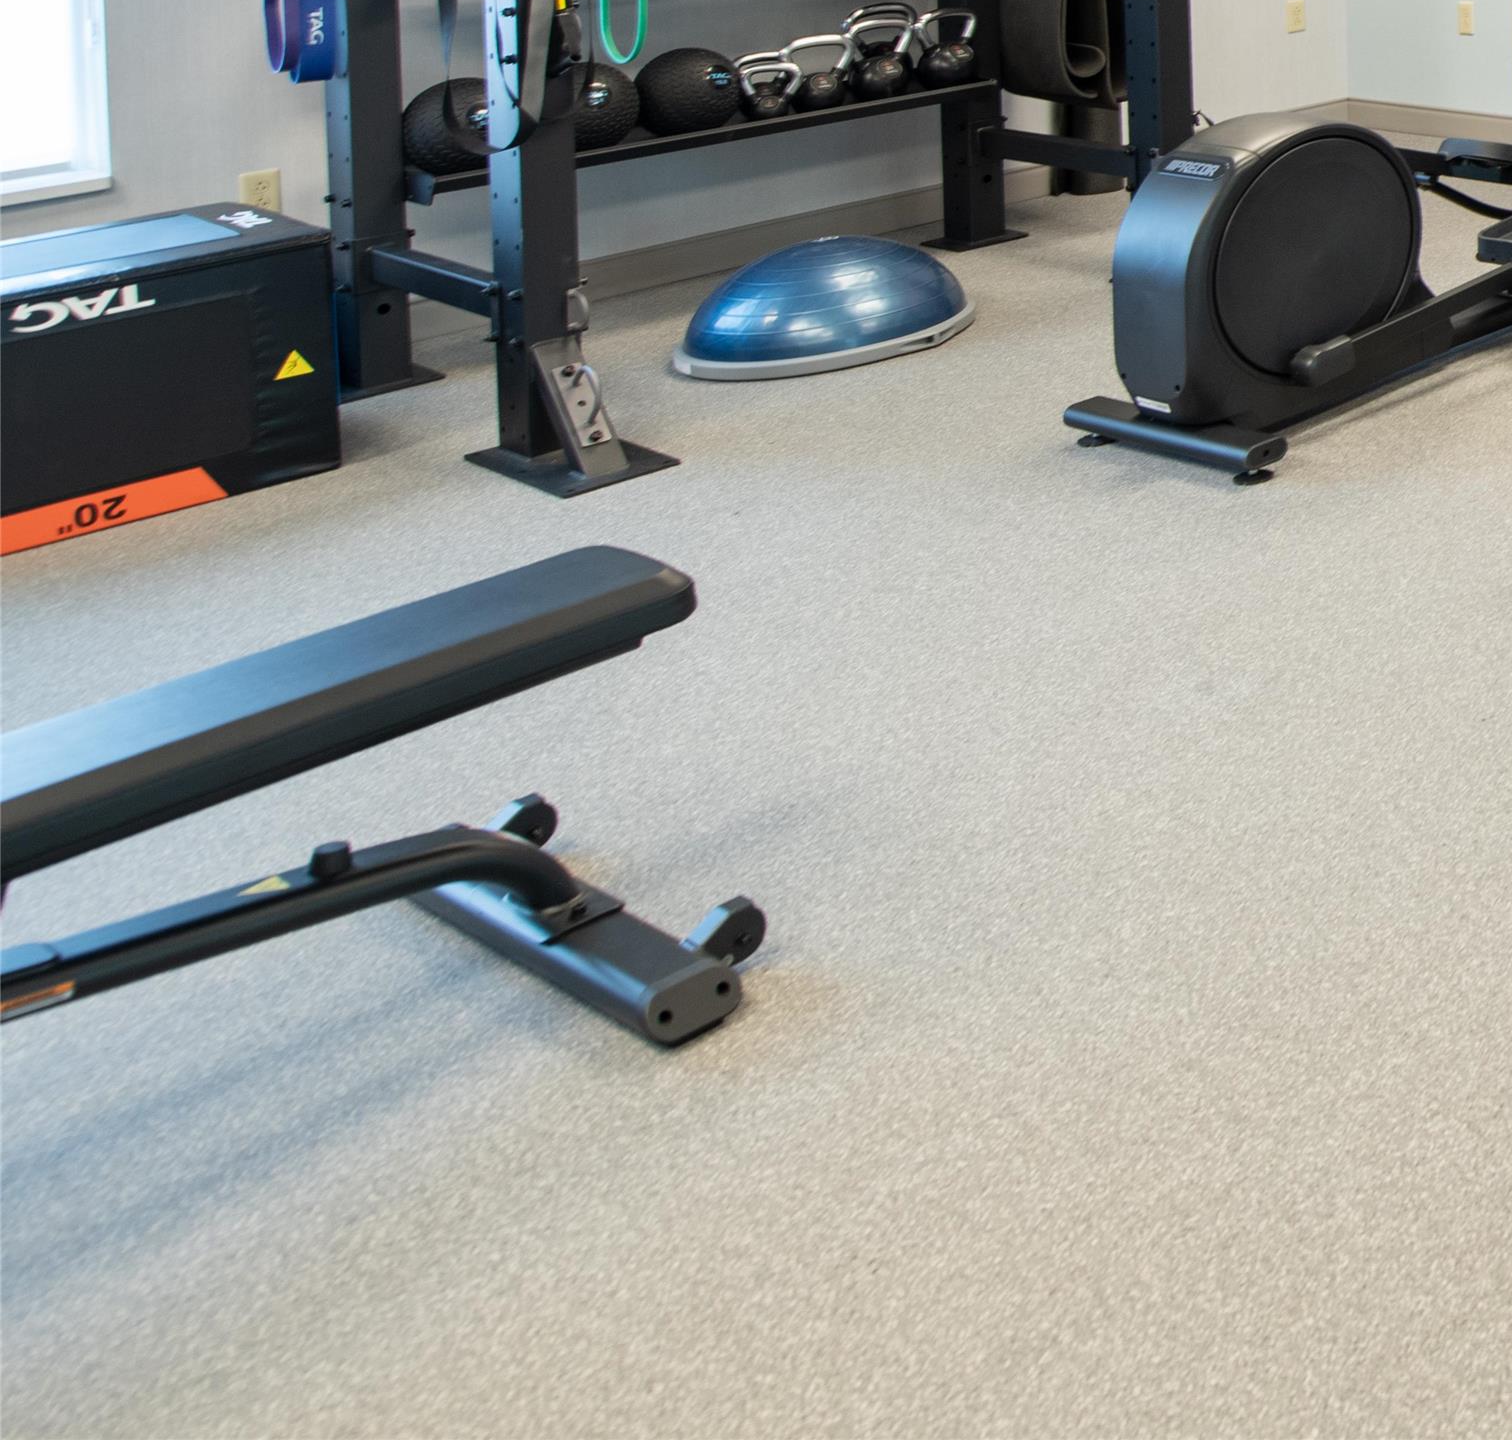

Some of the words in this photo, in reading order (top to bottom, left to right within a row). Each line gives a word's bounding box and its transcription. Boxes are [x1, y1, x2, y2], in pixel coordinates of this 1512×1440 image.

[307, 6, 325, 46] TAG
[1172, 159, 1221, 177] PRECOR
[8, 283, 157, 334] TAG
